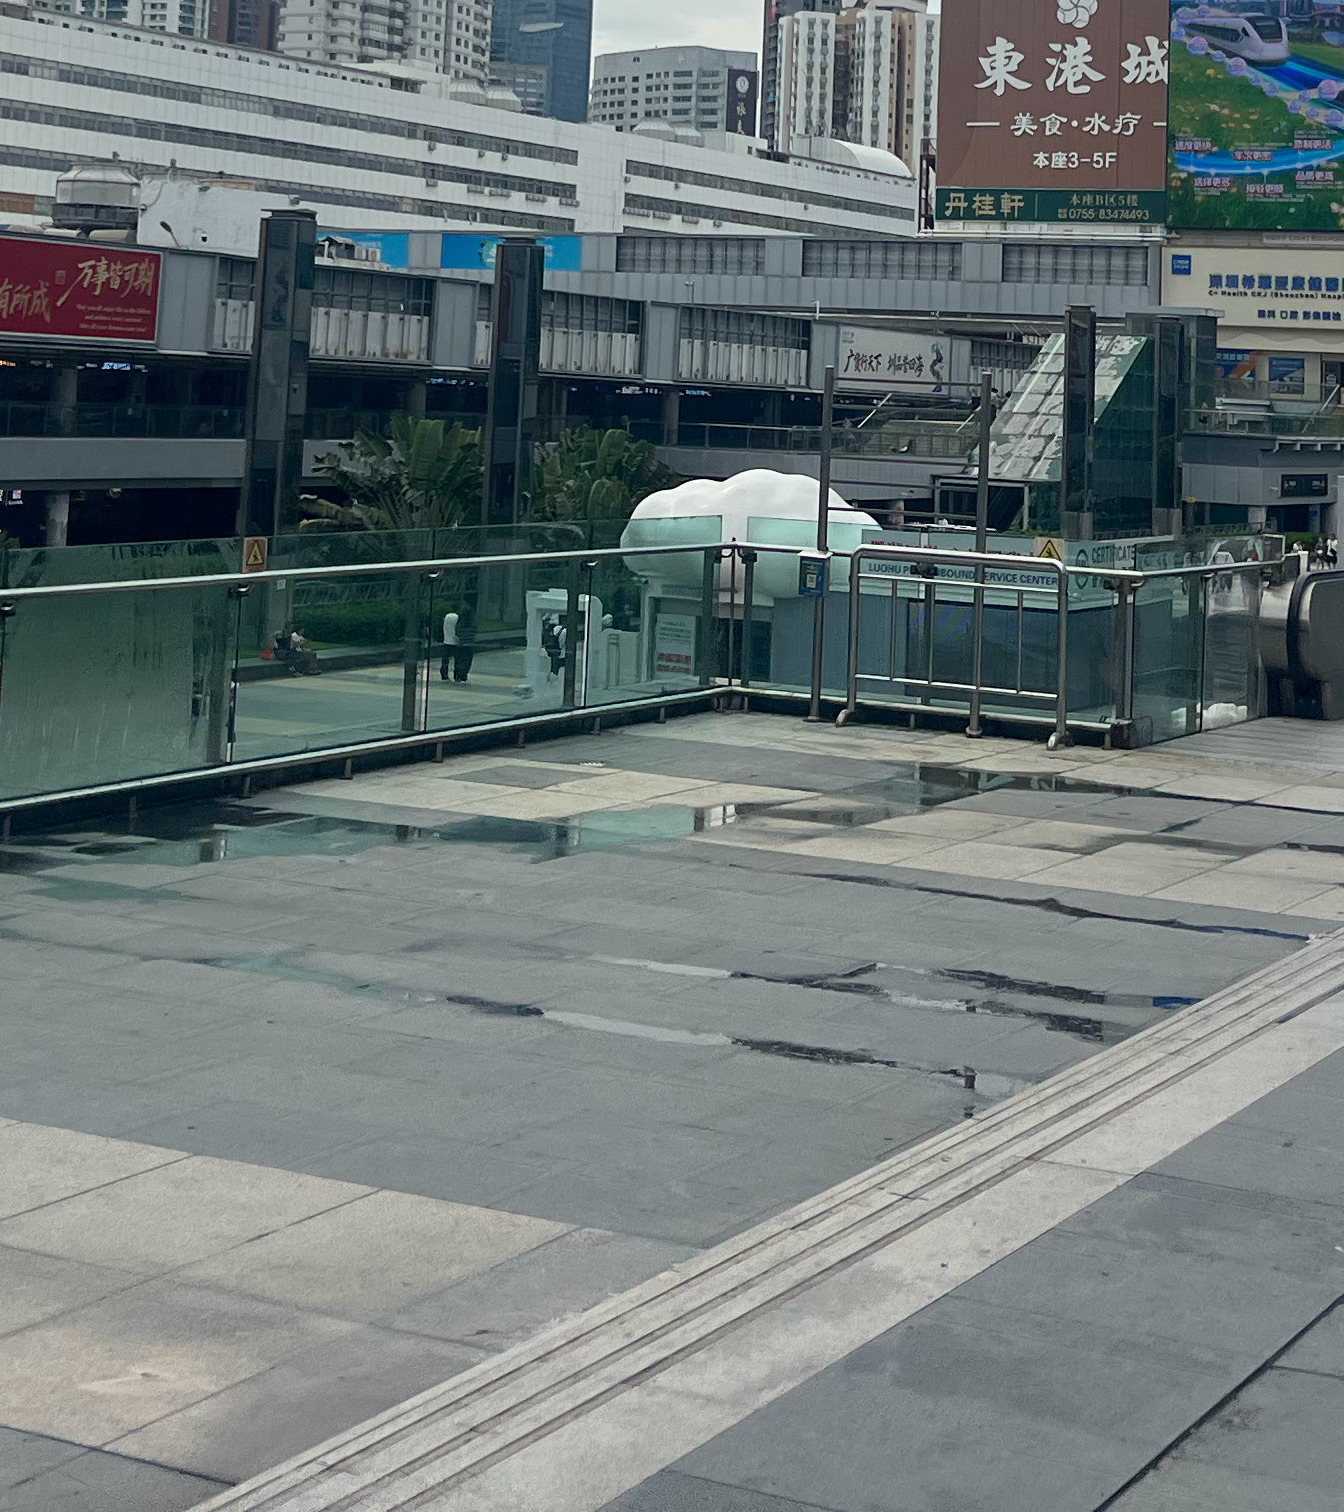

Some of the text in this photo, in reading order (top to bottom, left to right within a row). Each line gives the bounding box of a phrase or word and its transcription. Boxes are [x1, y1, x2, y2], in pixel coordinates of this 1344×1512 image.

[974, 35, 1169, 97] 東港城
[1032, 151, 1118, 170] 本座3-5F
[944, 192, 1024, 218] 丹桂軒
[1221, 290, 1249, 298] Health
[868, 563, 902, 574] LUOHU
[979, 571, 1018, 583] ERVICE
[1019, 574, 1057, 585] CENTER
